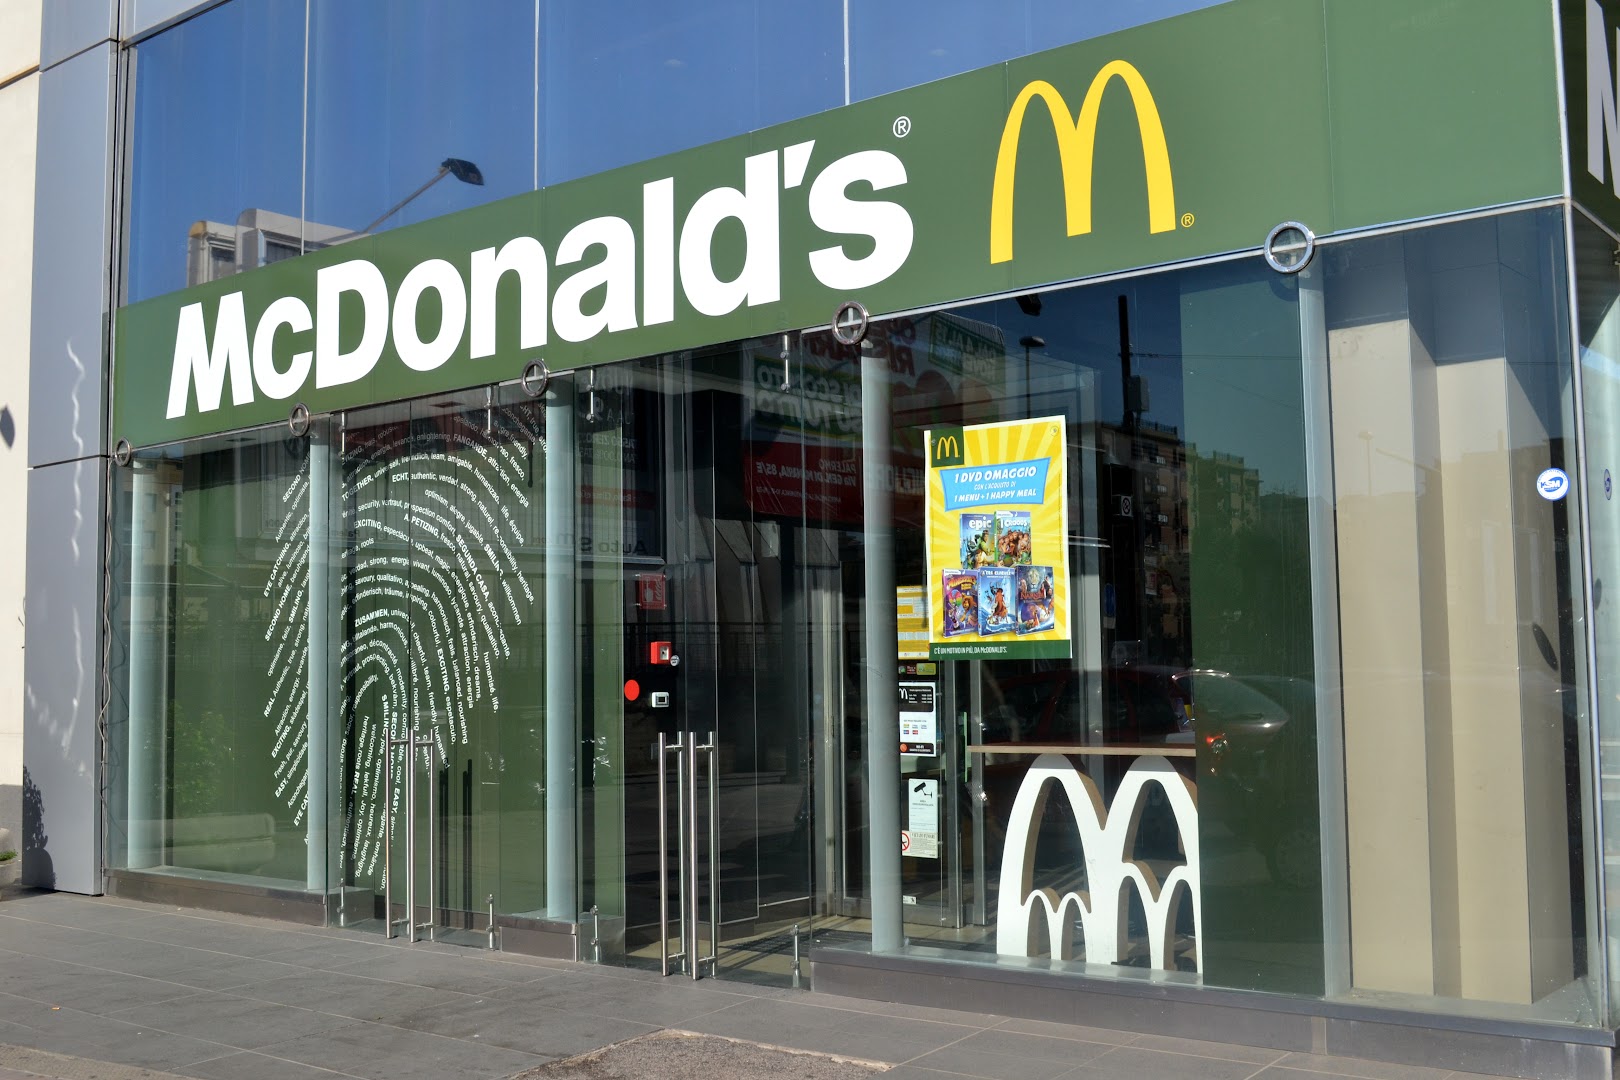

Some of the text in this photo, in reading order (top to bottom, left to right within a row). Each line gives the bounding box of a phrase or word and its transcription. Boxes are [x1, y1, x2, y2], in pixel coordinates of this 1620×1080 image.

[165, 139, 914, 419] McDonald's
[282, 474, 301, 503] SECOND
[341, 473, 374, 502] TOGETHER,
[447, 455, 473, 472] amigable,
[501, 505, 510, 521] life,
[453, 433, 487, 461] FANGANDE,
[510, 483, 529, 508] energia
[509, 456, 525, 481] fresco,
[955, 466, 1037, 483] 1 DVD OMAGGIO
[974, 483, 984, 491] CON
[985, 481, 1010, 490] L'ACQUISTO
[958, 493, 980, 502] MENU
[989, 490, 1016, 500] HAPPY
[1017, 488, 1037, 497] MEAL
[361, 537, 375, 548] roots
[392, 472, 410, 482] ECHT,
[439, 474, 460, 488] verdad,
[460, 482, 477, 504] strong,
[477, 500, 495, 527] naturel,
[516, 570, 535, 605] heritage,
[969, 516, 992, 530] epic
[263, 580, 273, 598] EYE
[270, 542, 292, 581] CATCHING,
[424, 489, 449, 509] optimism,
[465, 519, 484, 547] jugable,
[501, 579, 522, 626] willkommen
[440, 532, 483, 615] fresco, natural, savoury,
[455, 534, 478, 576] SEGUNDA
[475, 573, 490, 602] CASA,
[264, 608, 281, 642] SECOND
[279, 583, 293, 609] HOME,
[288, 589, 304, 624] SMILING,
[354, 518, 482, 702] EXCITING, upbeat, magic, energique, erfinderisch, dreams,
[430, 591, 452, 638] harmonisch,
[413, 559, 430, 574] vivant,
[431, 567, 453, 598] luminoso,
[450, 596, 464, 632] lysande,
[461, 632, 471, 675] attraction,
[466, 676, 474, 709] energia
[427, 610, 442, 648] colourful,
[437, 647, 451, 695] EXCITING,
[447, 637, 457, 659] frais,
[263, 697, 276, 718] REAL
[287, 649, 297, 665] true,
[294, 622, 306, 648] strong,
[354, 608, 389, 628] ZUSAMMEN,
[412, 632, 428, 667] cheerful,
[423, 666, 432, 691] team,
[428, 691, 438, 725] friendly,
[452, 659, 463, 701] balanced,
[396, 667, 408, 711] modernity,
[271, 724, 292, 759] EXCITING,
[457, 701, 469, 745] nourishing
[364, 723, 377, 769] welcoming,
[377, 738, 387, 756] joie,
[274, 777, 289, 798] EASY,
[395, 765, 405, 785] cool,
[293, 809, 305, 827] EYE
[365, 802, 377, 838] heureux,
[391, 787, 400, 814] EASY,
